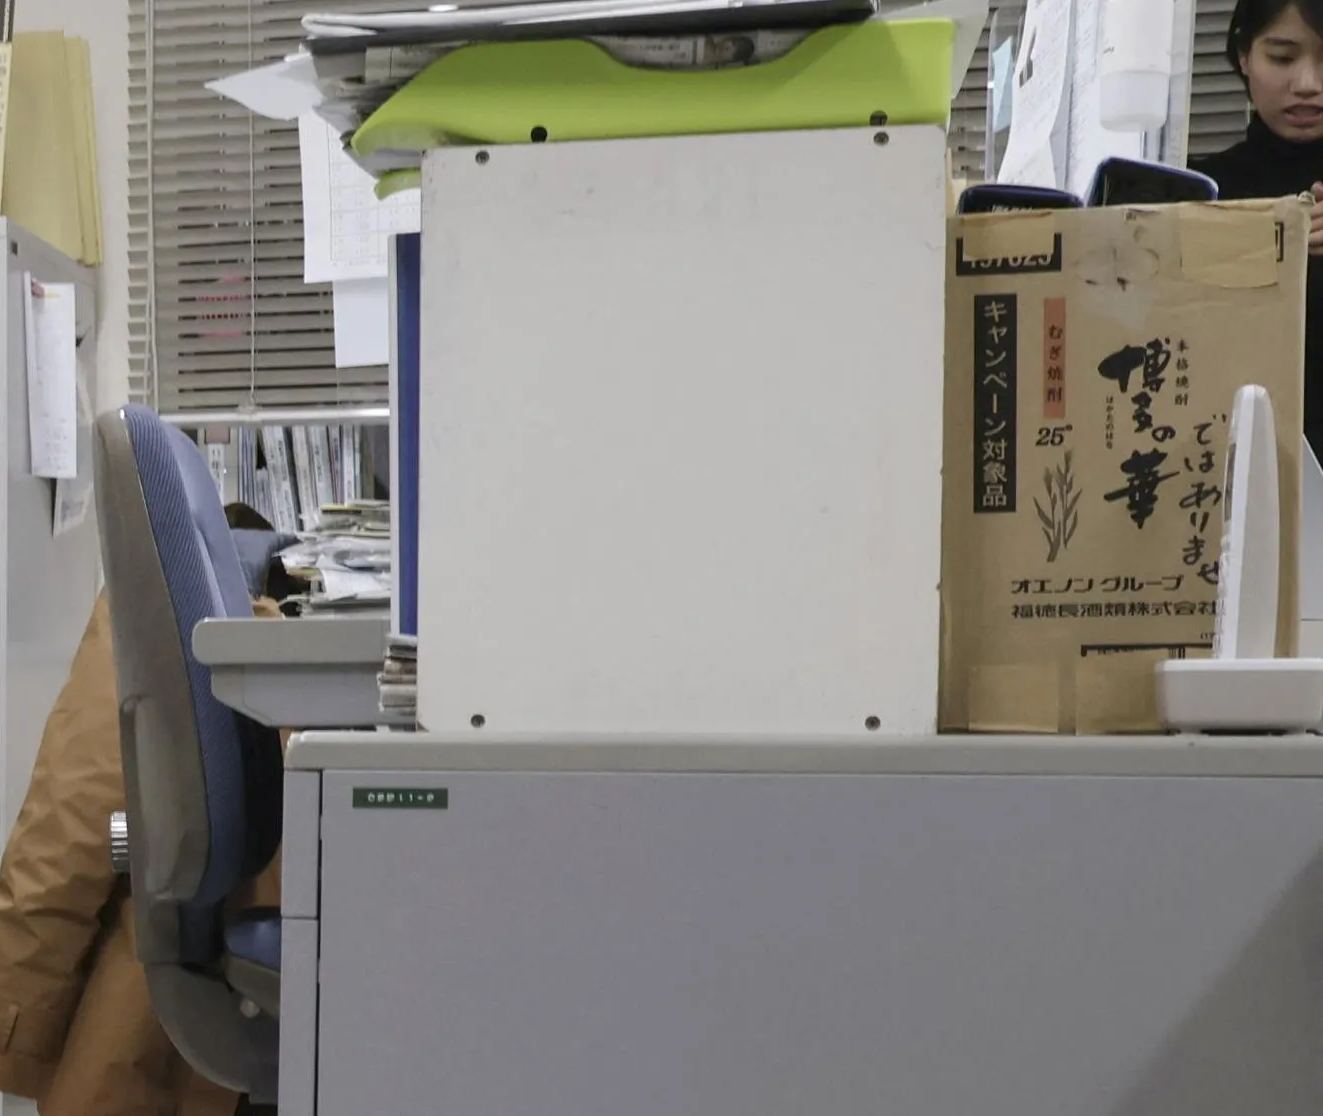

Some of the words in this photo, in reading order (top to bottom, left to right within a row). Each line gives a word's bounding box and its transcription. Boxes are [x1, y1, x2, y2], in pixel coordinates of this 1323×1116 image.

[1045, 324, 1064, 403] むぎ焼酎
[1173, 338, 1190, 407] 本格焼酎
[981, 299, 1009, 508] キャンペーン対象品
[1097, 337, 1181, 530] 博多の華
[1011, 600, 1217, 619] 福徳長酒類株式会社
